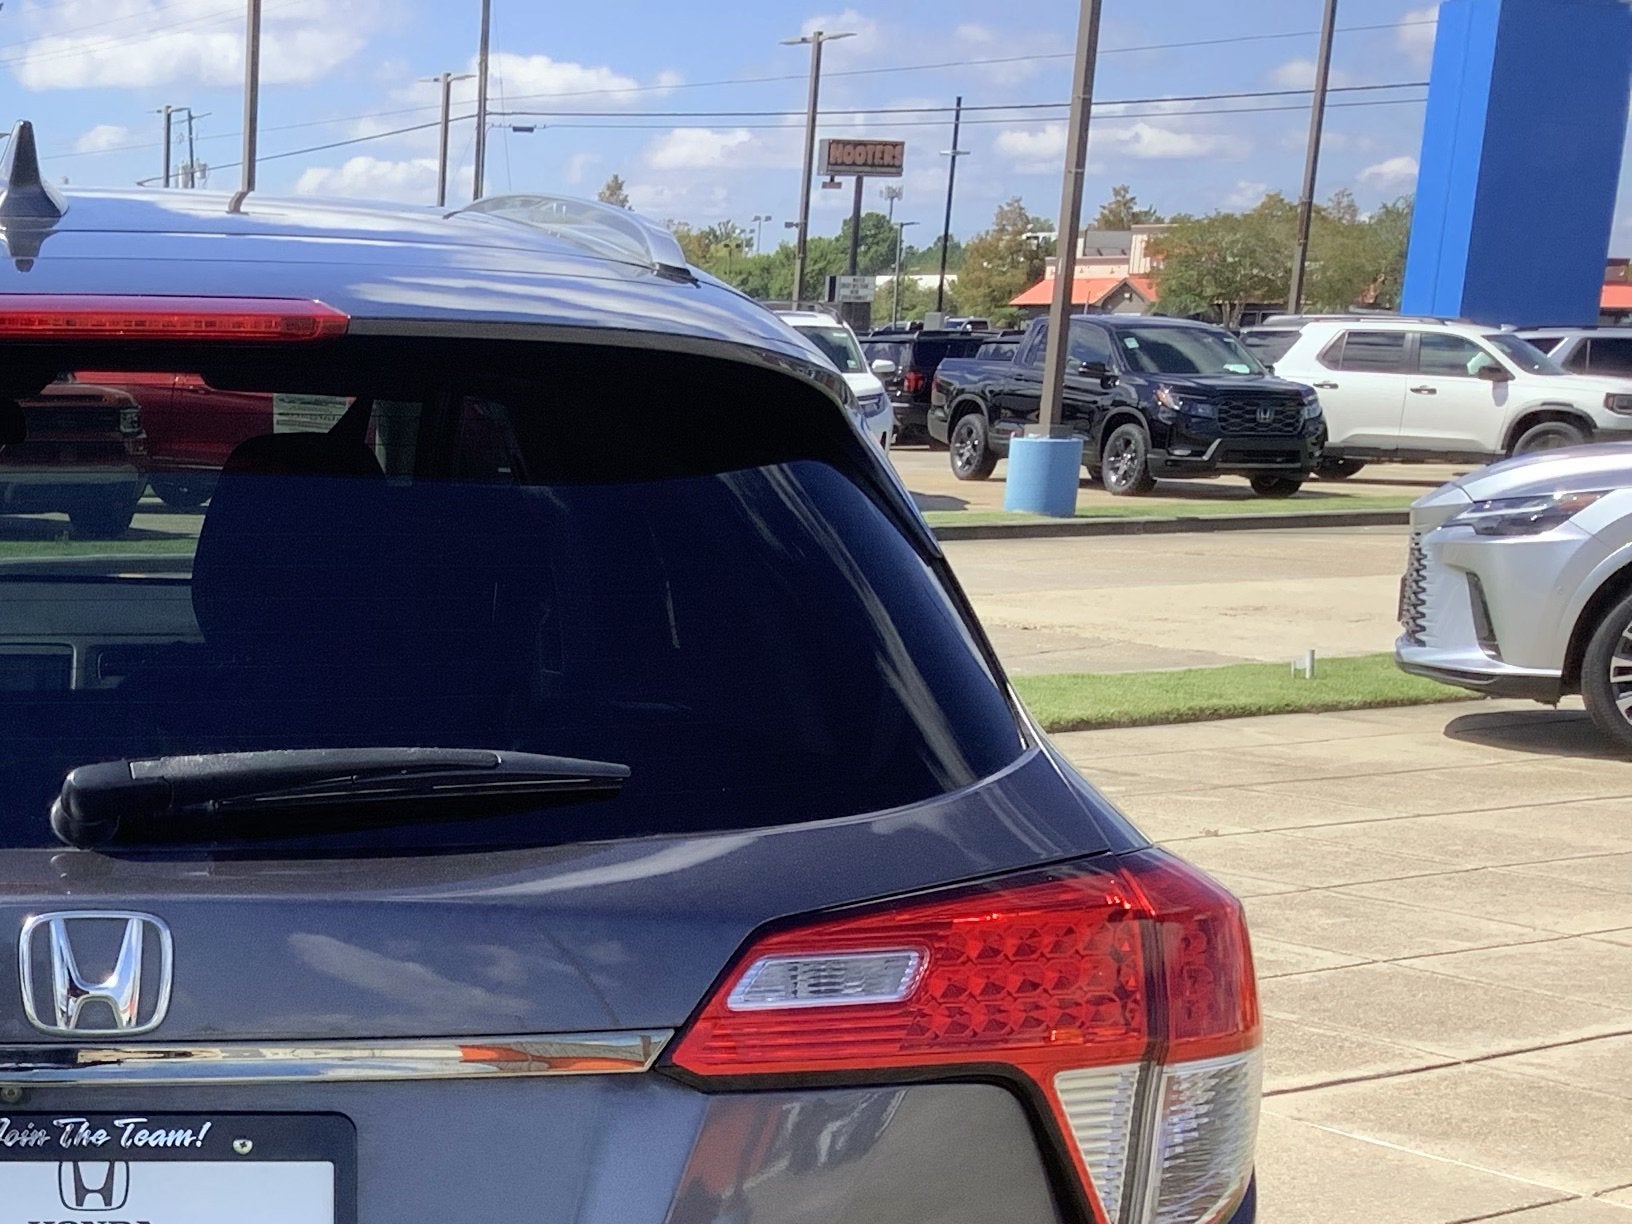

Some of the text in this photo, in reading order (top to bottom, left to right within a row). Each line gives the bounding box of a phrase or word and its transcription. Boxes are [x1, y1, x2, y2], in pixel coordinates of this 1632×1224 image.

[829, 143, 903, 166] HOOTERS
[53, 1117, 111, 1149] The
[114, 1117, 212, 1149] Team!
